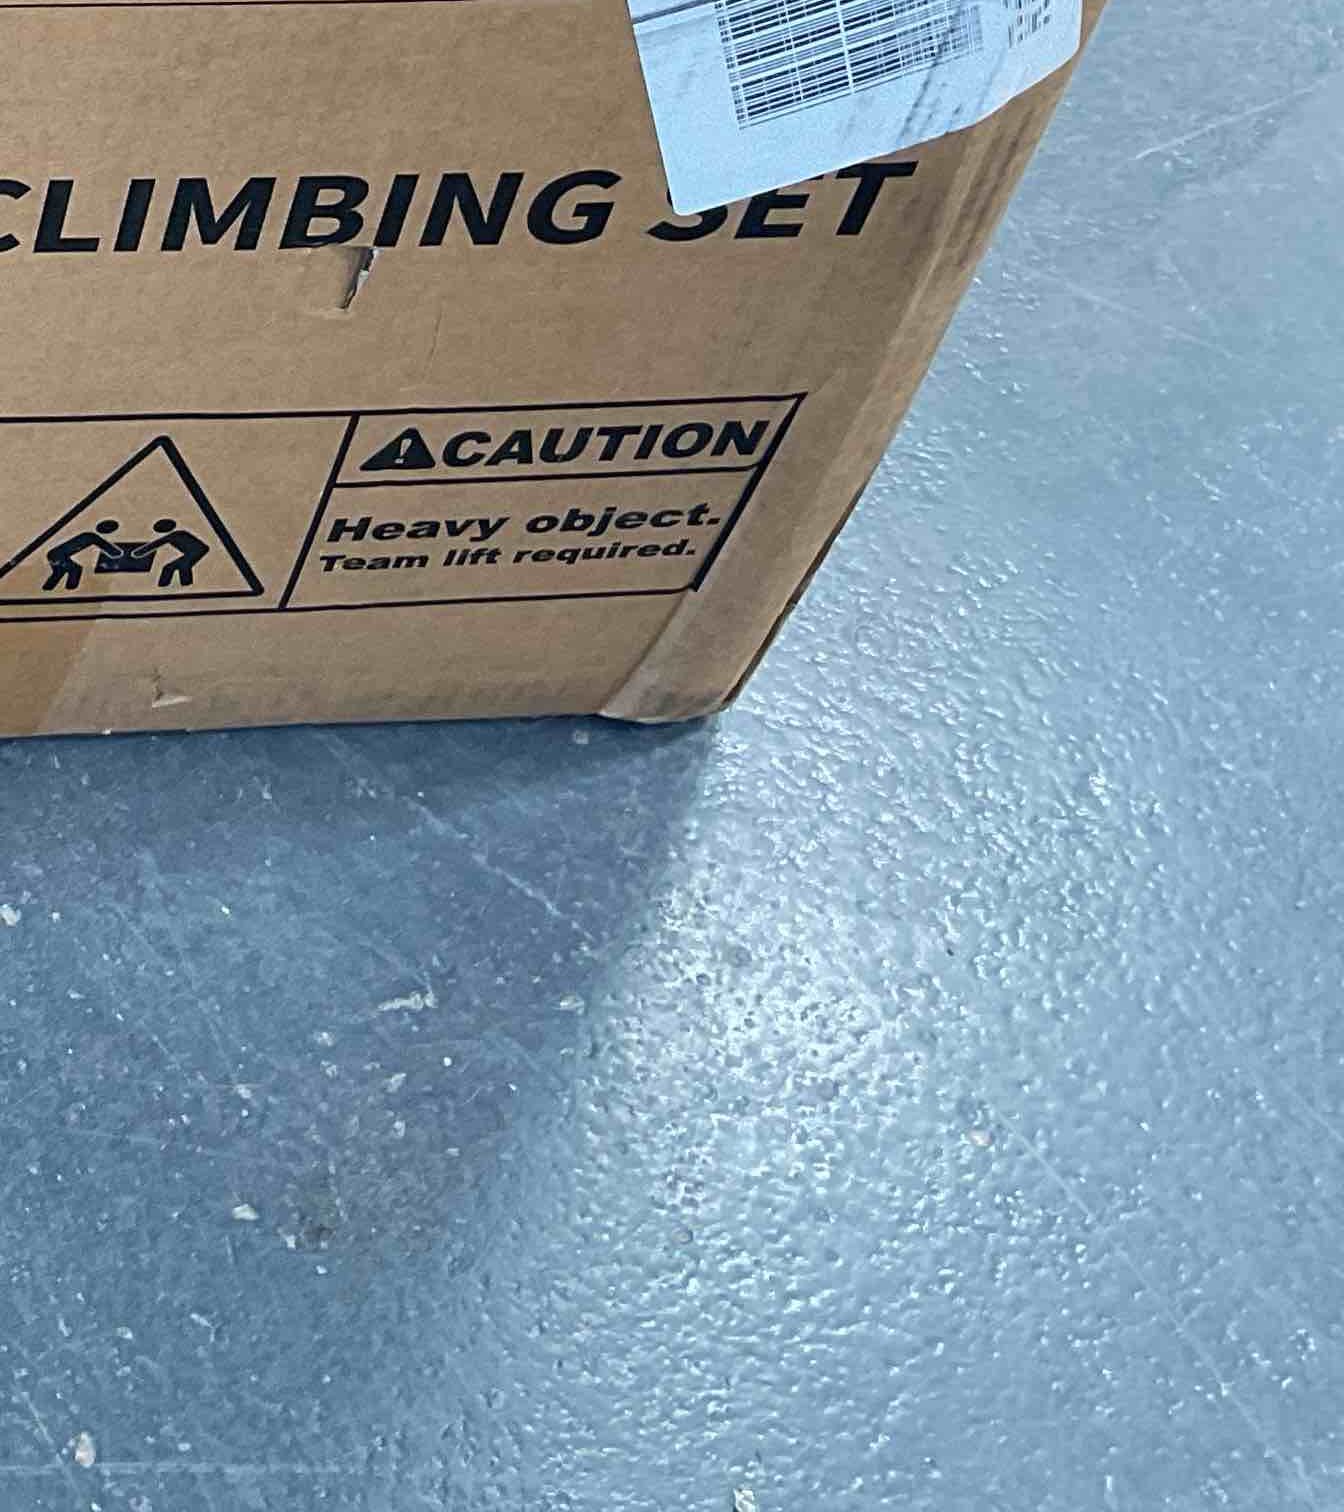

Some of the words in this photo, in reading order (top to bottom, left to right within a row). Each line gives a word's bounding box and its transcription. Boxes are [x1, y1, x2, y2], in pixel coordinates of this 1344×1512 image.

[442, 420, 770, 468] CAUTION
[326, 516, 510, 543] Heavy
[525, 502, 721, 537] object.
[319, 554, 429, 572] Team
[442, 547, 502, 567] lift
[512, 538, 696, 565] required.
